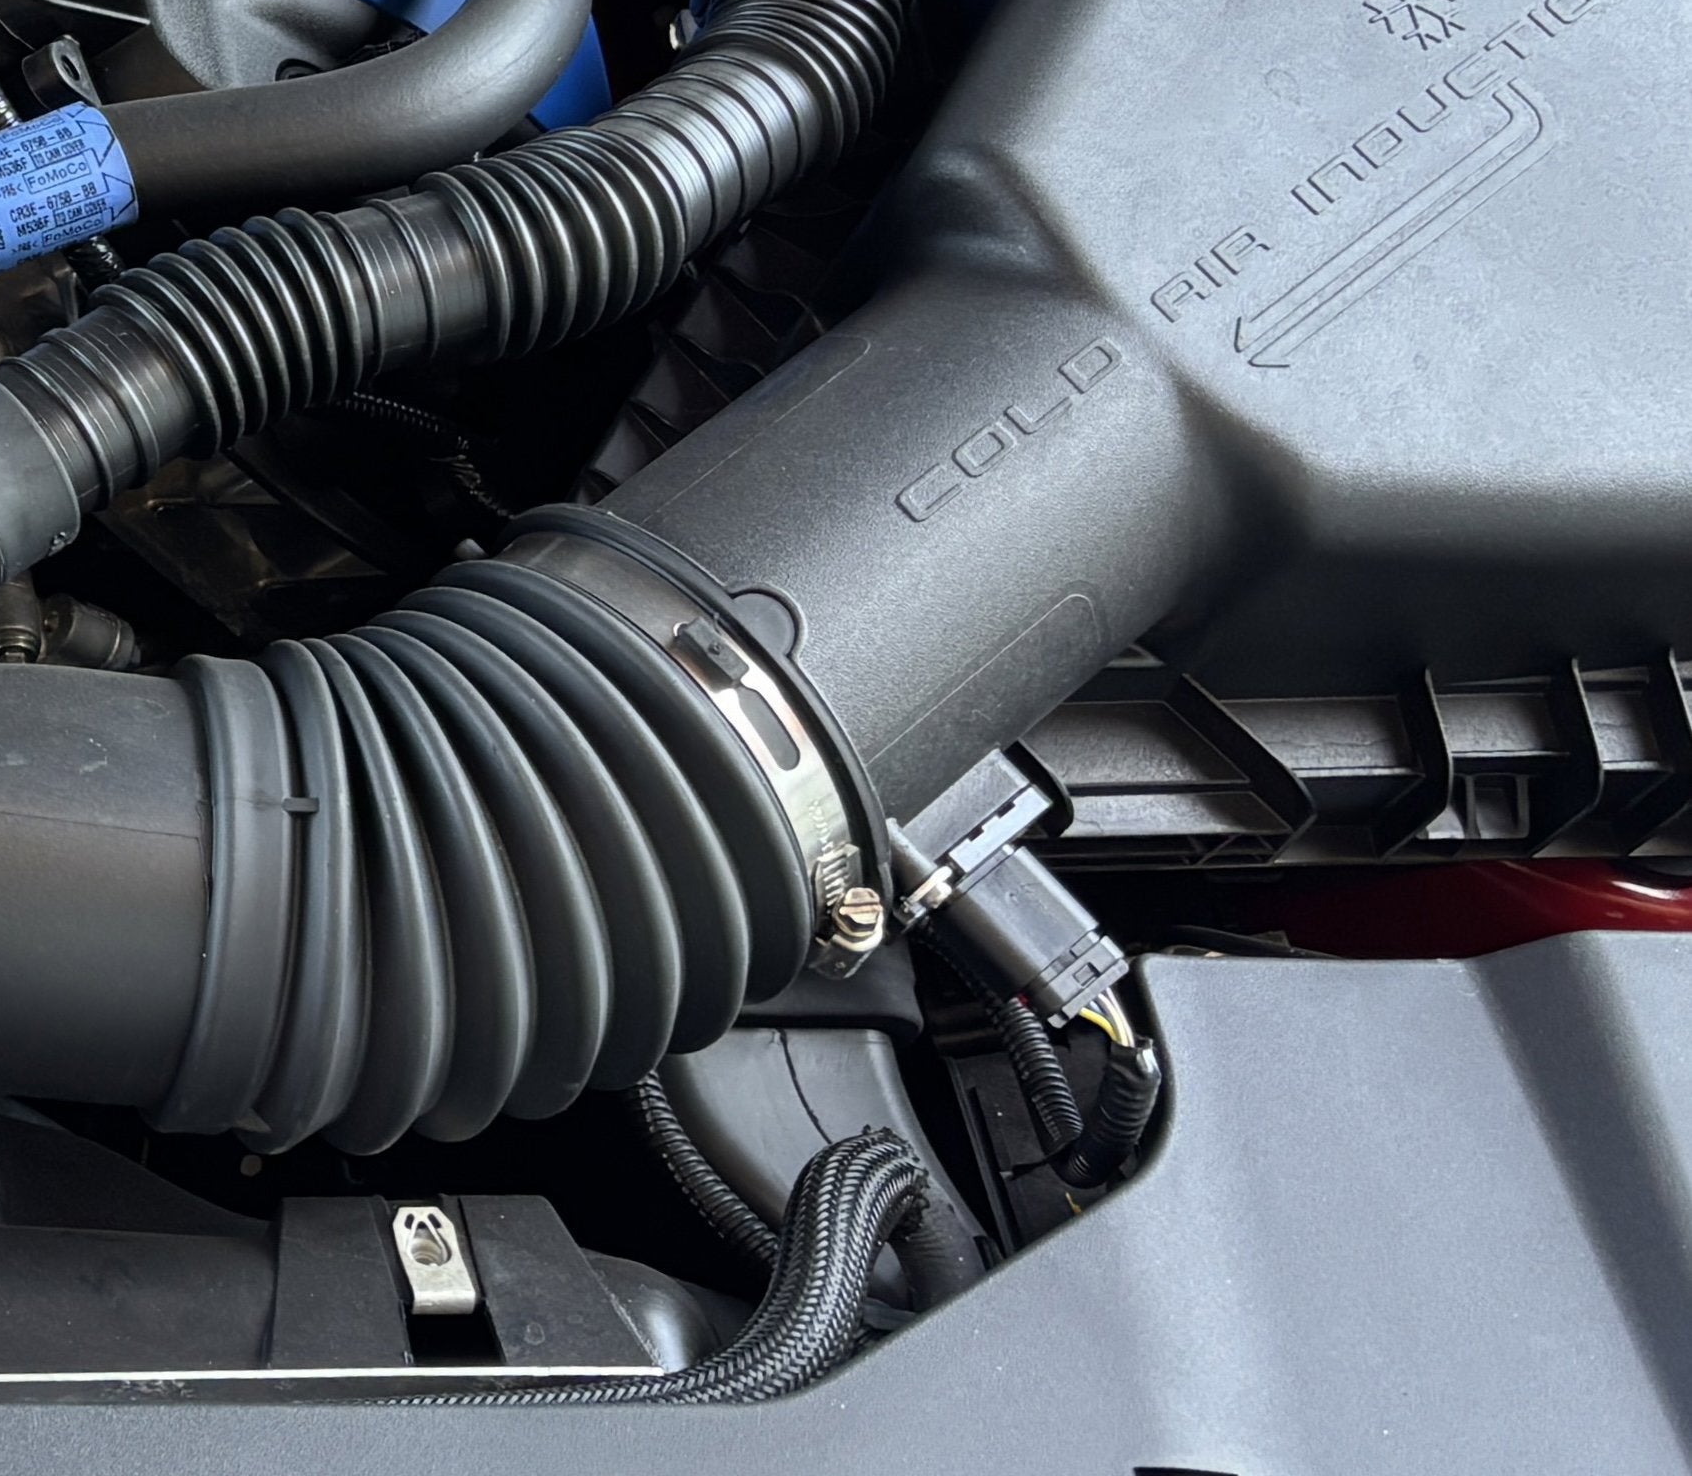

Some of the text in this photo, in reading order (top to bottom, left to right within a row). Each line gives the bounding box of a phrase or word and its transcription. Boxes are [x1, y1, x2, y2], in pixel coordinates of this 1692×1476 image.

[26, 160, 88, 188] FoMoCo
[45, 217, 103, 245] FoMoCo
[896, 333, 1129, 523] COLD
[1148, 223, 1276, 325] AIR
